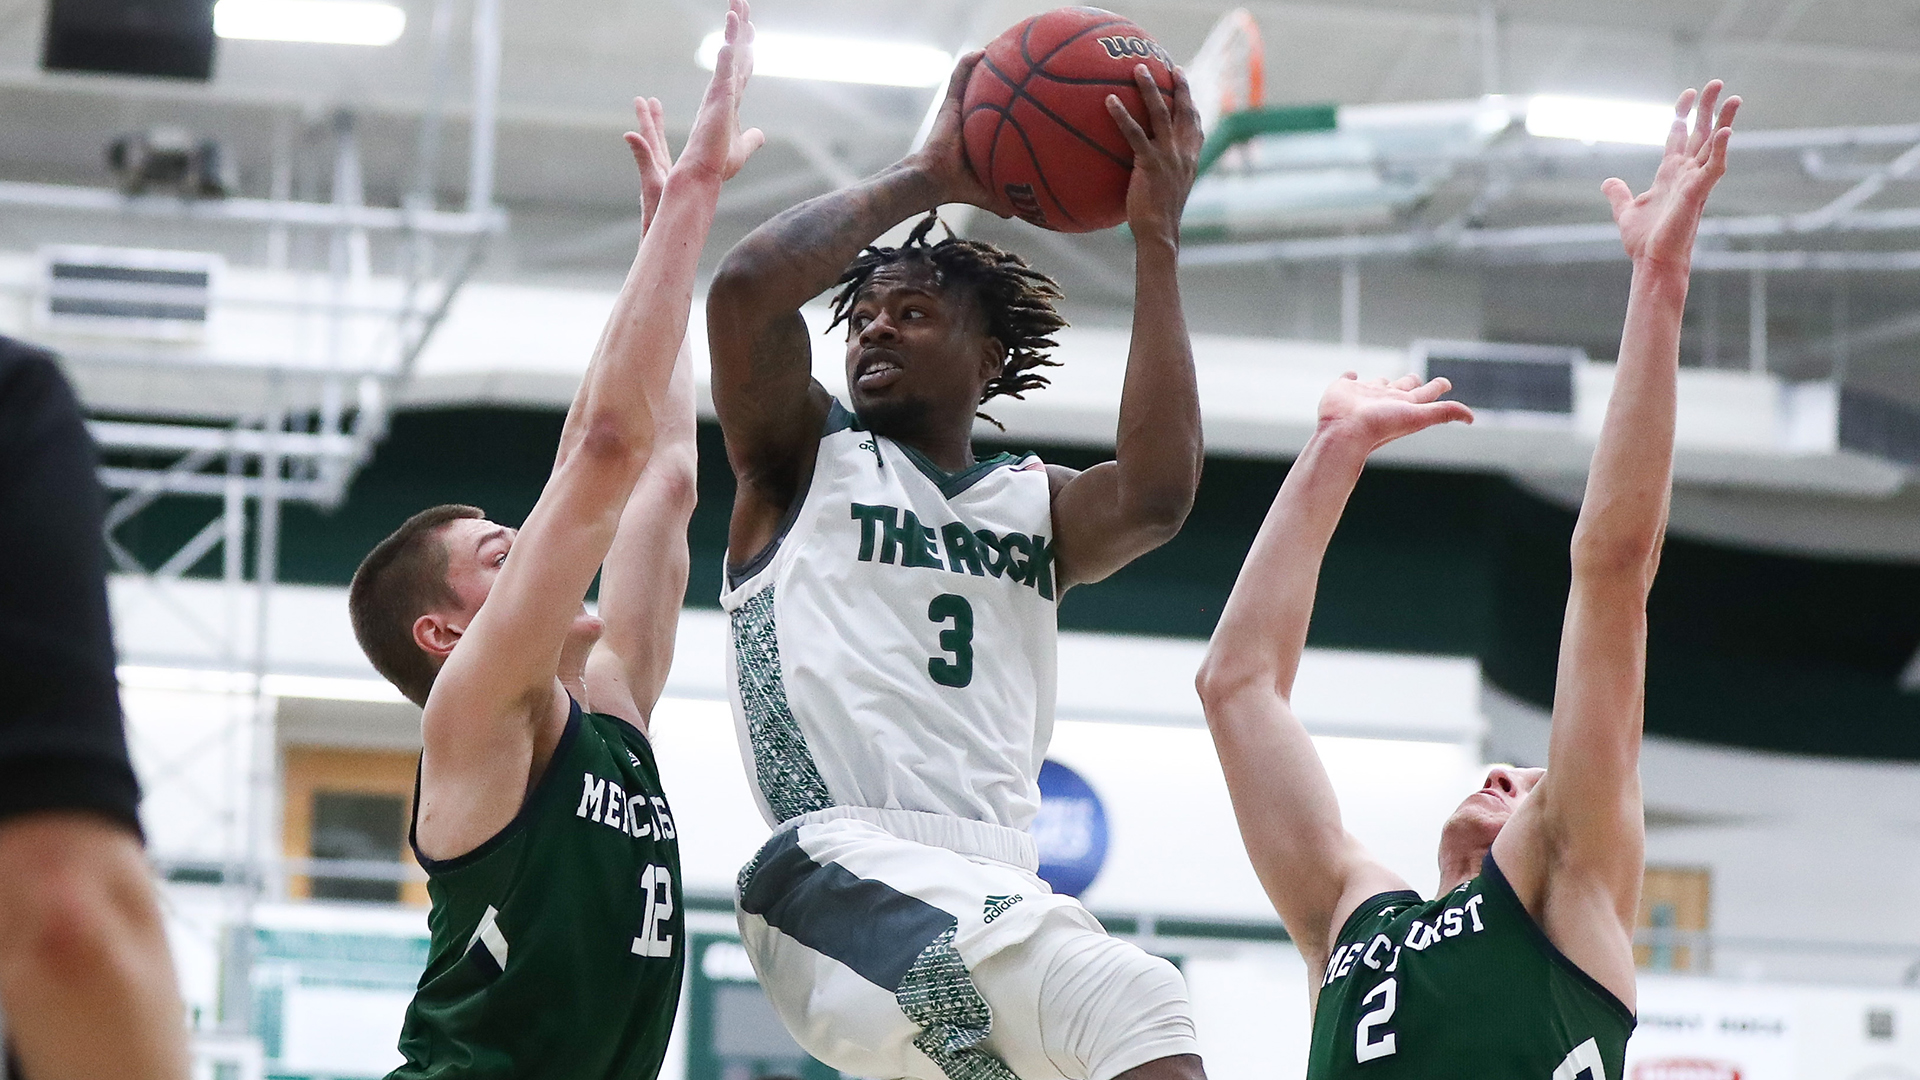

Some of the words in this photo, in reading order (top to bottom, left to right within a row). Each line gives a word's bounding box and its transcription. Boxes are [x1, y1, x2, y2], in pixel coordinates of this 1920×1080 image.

[850, 502, 944, 571] THE
[941, 521, 1055, 601] ROCK
[928, 593, 973, 688] 3
[631, 864, 673, 957] 12
[984, 894, 1023, 924] adidas
[1357, 977, 1397, 1064] 2
